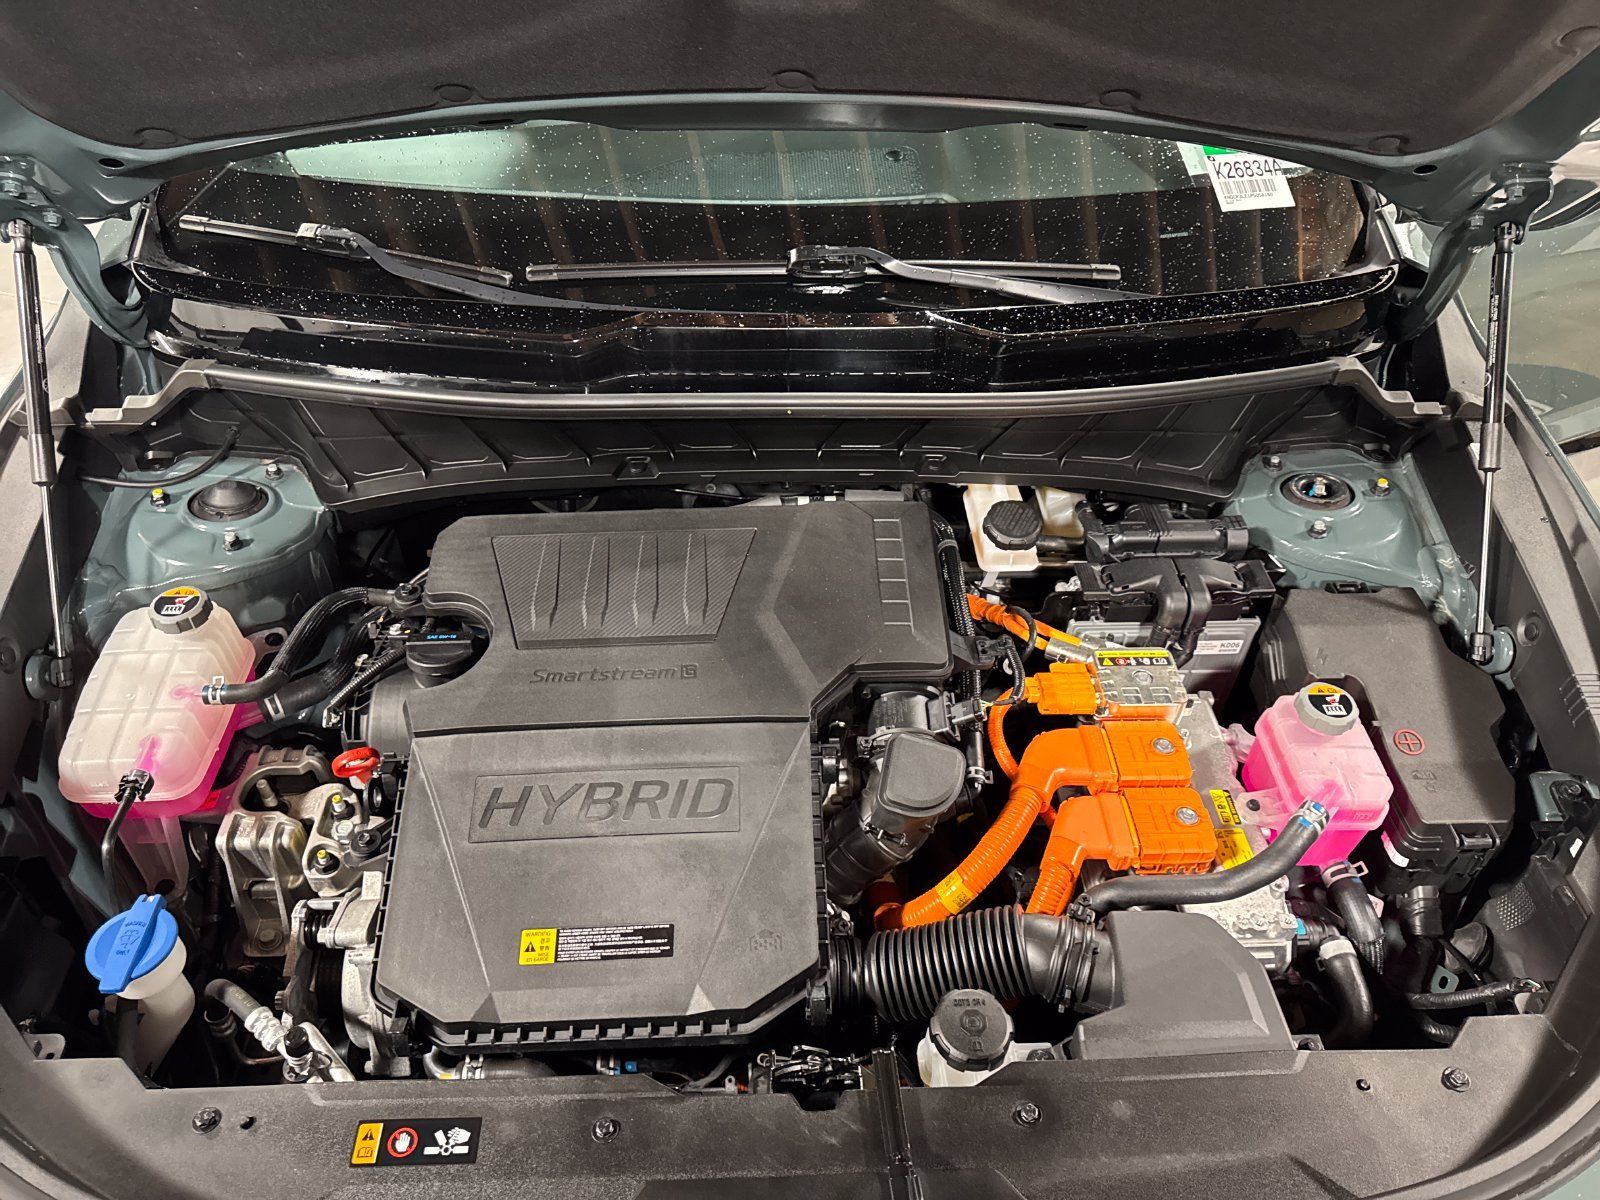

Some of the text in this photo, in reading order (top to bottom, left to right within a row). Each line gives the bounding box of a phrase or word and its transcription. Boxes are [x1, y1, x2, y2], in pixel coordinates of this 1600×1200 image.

[1212, 159, 1282, 180] K26834A
[529, 666, 678, 684] Smartstream
[478, 778, 734, 829] HYBRID
